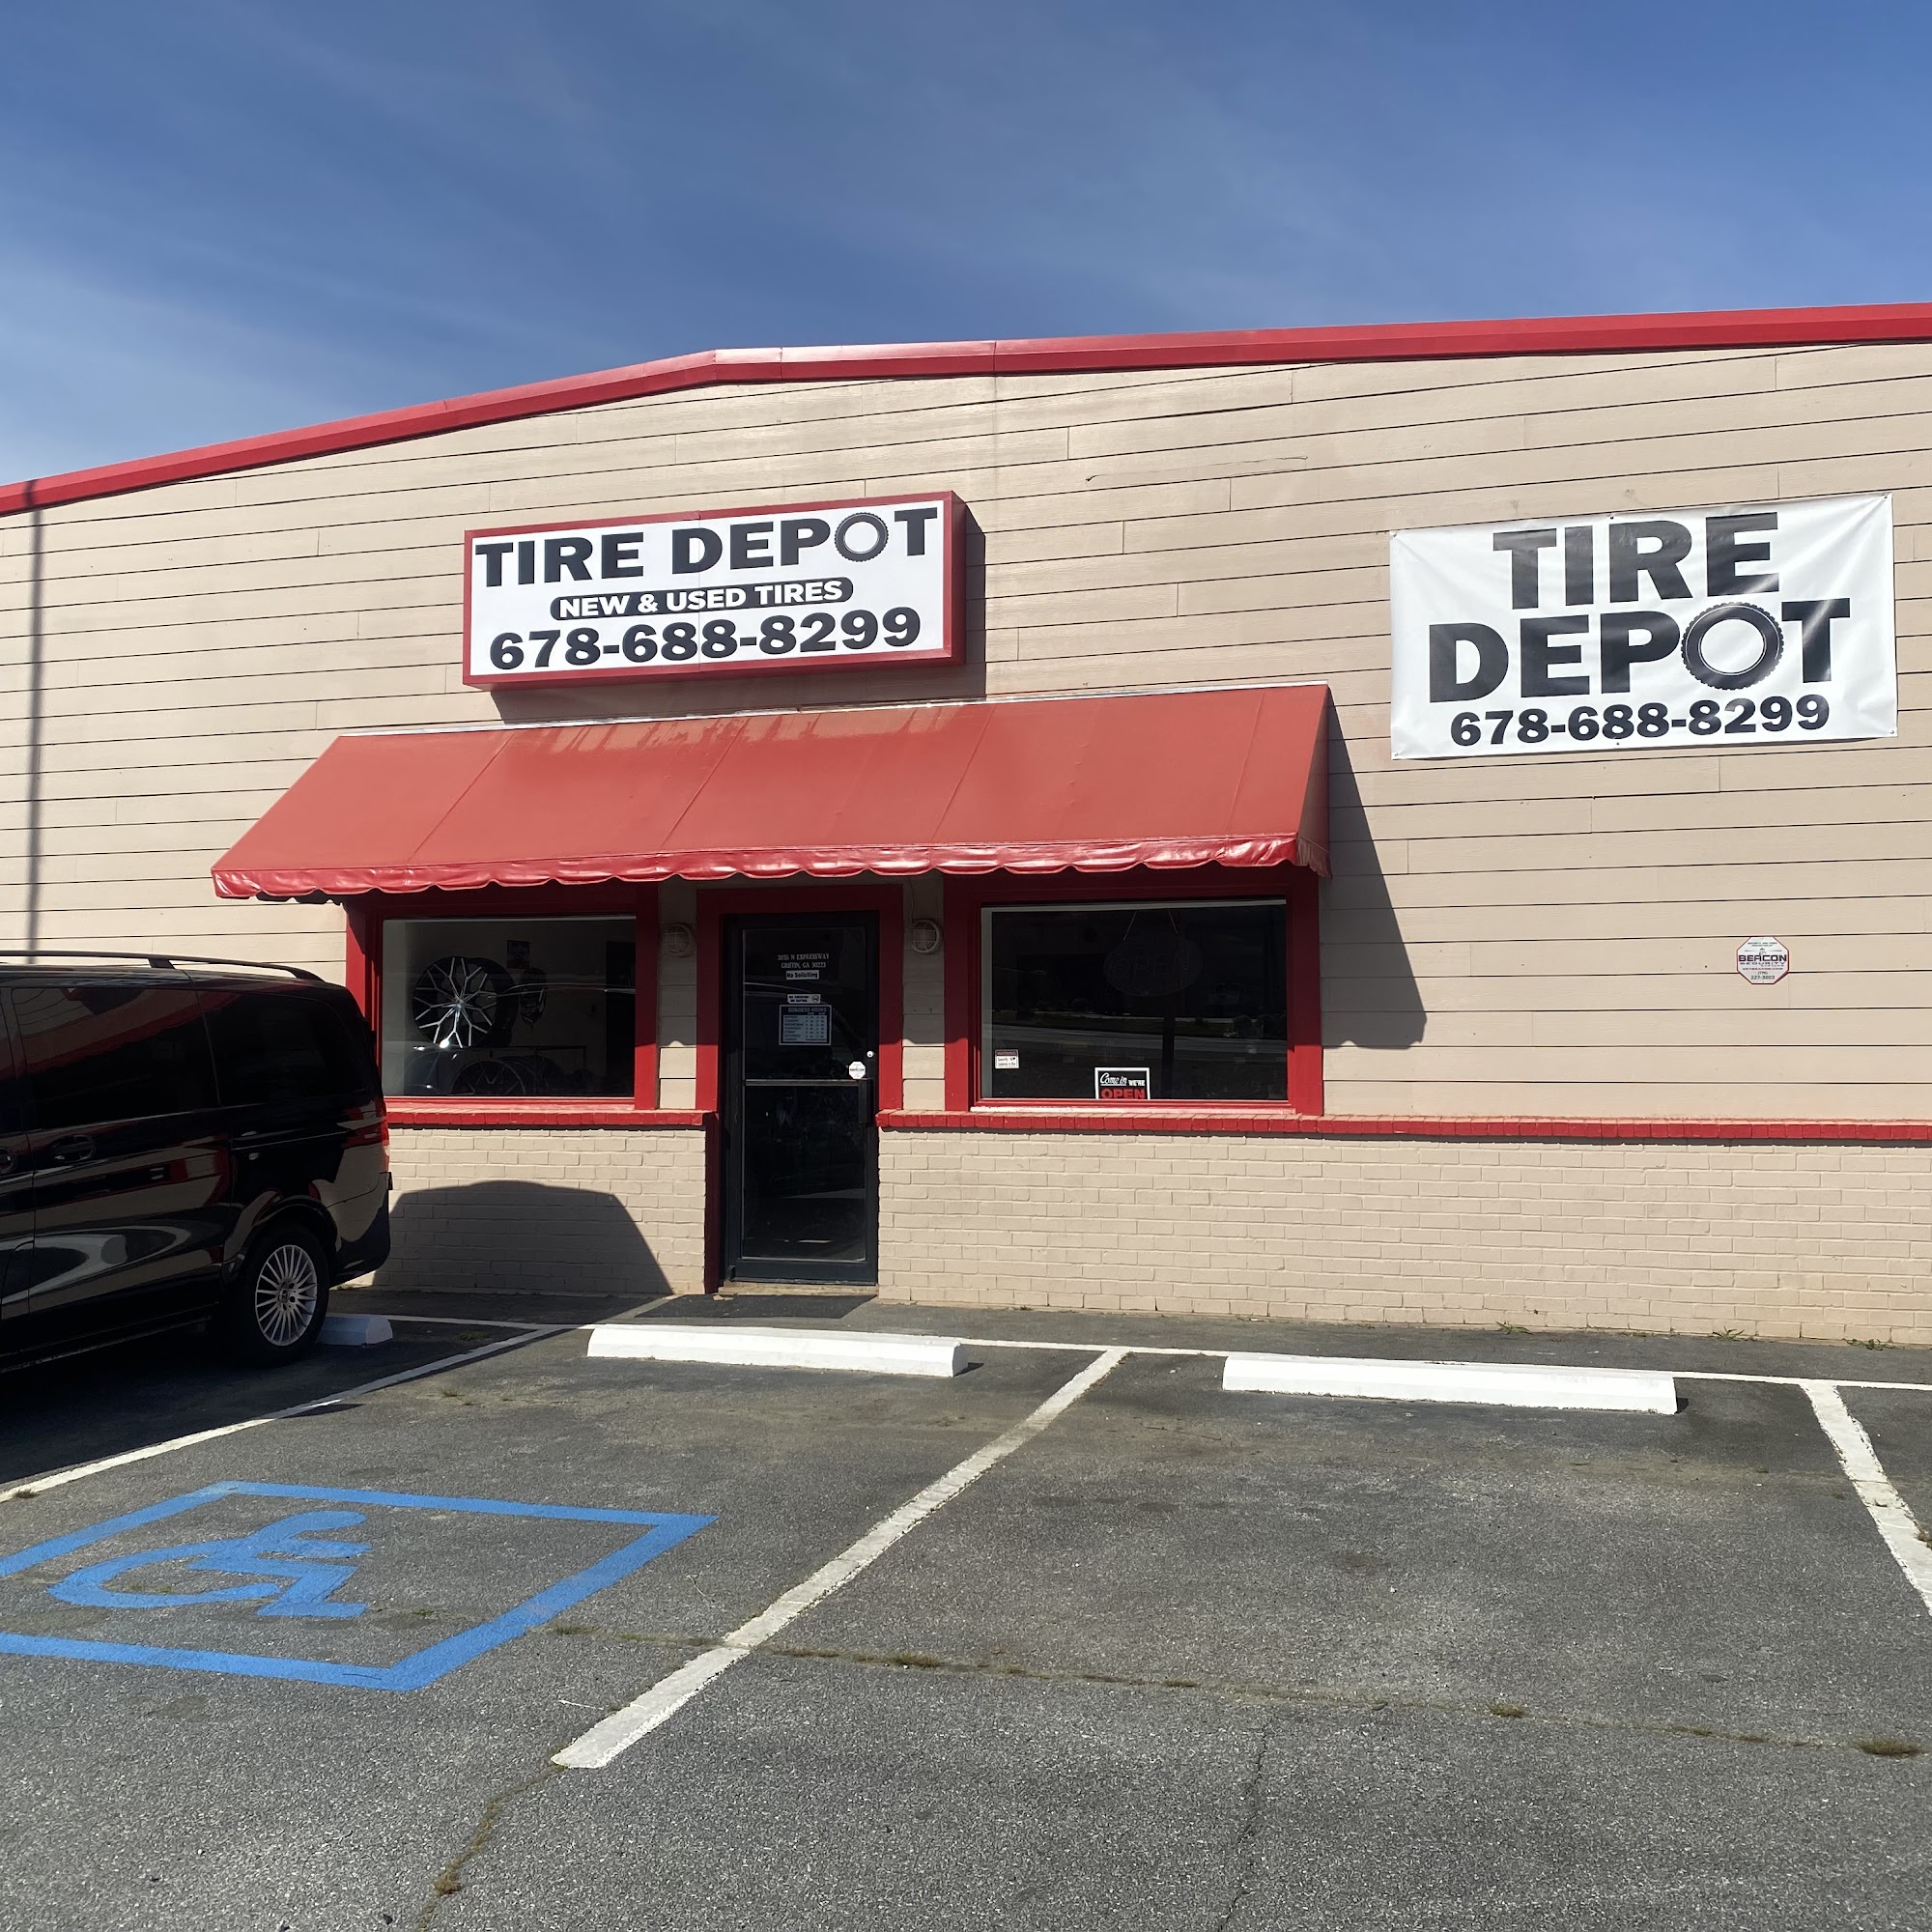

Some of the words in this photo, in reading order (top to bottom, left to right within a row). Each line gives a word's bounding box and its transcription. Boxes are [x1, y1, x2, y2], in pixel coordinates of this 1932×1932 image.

[475, 532, 643, 587] TIRE
[672, 507, 938, 575] DEPOT
[1492, 512, 1779, 611] TIRE
[559, 595, 630, 618] NEW
[637, 593, 659, 613] &
[667, 587, 747, 611] USED
[753, 580, 843, 606] TIRES
[490, 607, 921, 670] 678-688-8299
[1429, 598, 1851, 703] DEPOT
[1450, 694, 1830, 747] 678-688-8299
[796, 952, 830, 961] EXPRESSWAY
[1099, 1072, 1121, 1085] Come
[1120, 1075, 1128, 1085] in
[1100, 1088, 1146, 1099] OPEN
